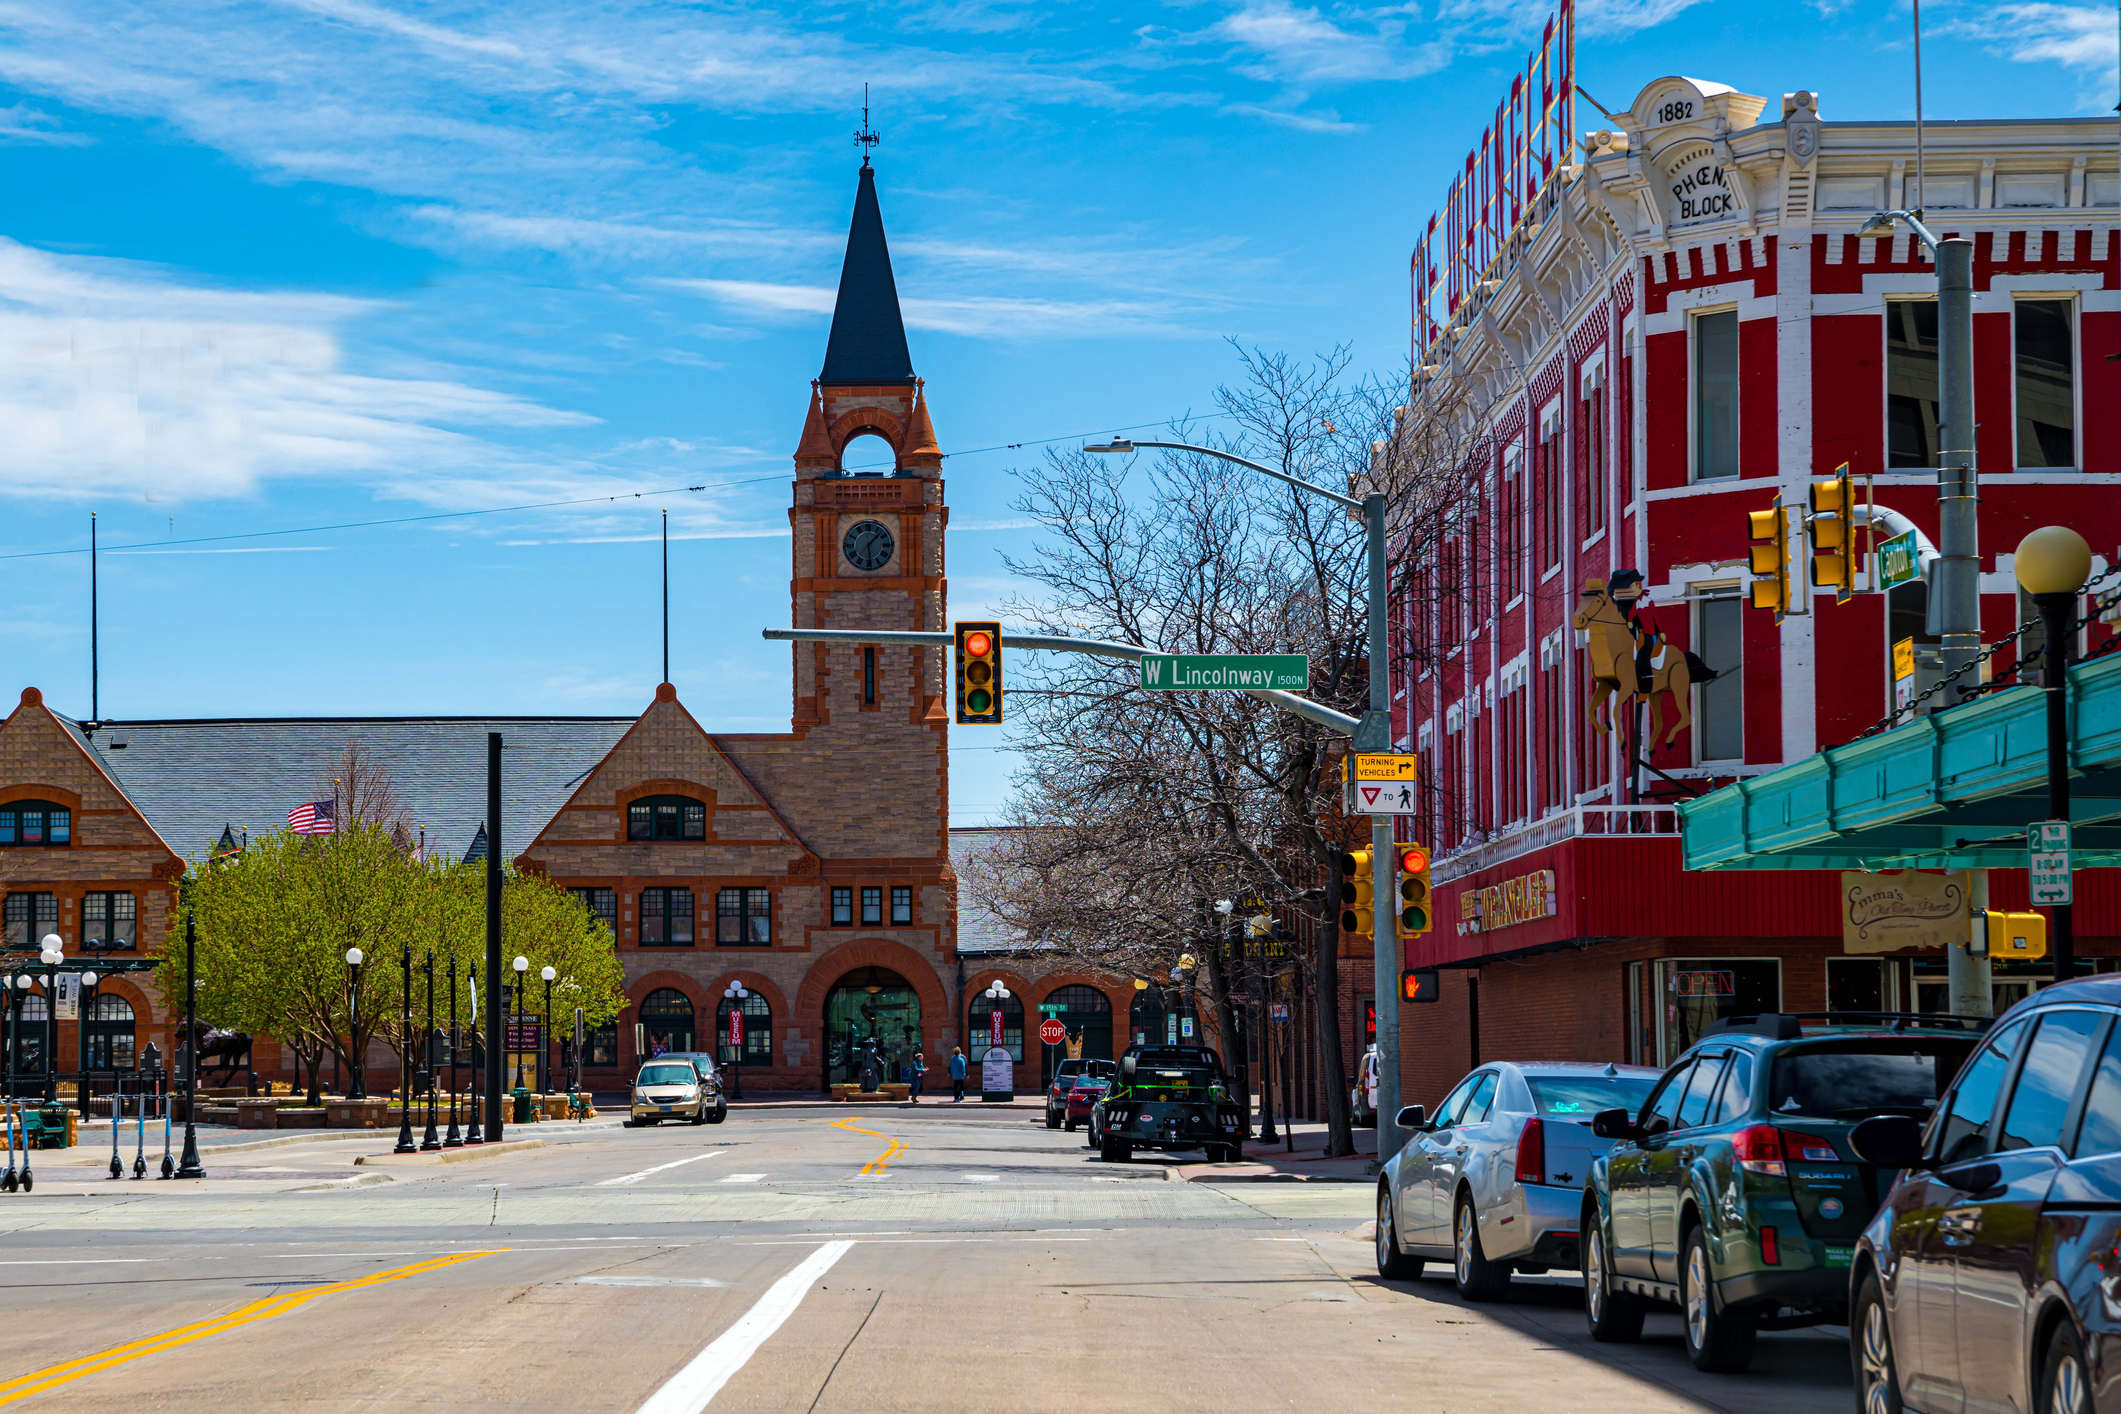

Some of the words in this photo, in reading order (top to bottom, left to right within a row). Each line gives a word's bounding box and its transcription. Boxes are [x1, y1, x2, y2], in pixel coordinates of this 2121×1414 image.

[1658, 102, 1692, 123] 1882
[1681, 193, 1732, 219] BLOCK
[1880, 537, 1909, 583] Capitol
[1145, 660, 1161, 685] W
[1172, 660, 1273, 688] Lincolnway
[1277, 675, 1303, 685] 1500N
[1359, 768, 1396, 776] VEHICLES
[1361, 758, 1394, 766] TURNING
[1383, 793, 1394, 801] TO
[2030, 830, 2040, 849] 2
[2036, 859, 2053, 870] 8:00
[2054, 858, 2064, 869] AM
[2033, 874, 2041, 885] TO
[2042, 874, 2058, 885] 5:00
[2059, 873, 2068, 884] PM
[1481, 869, 1552, 931] WRANGLER
[1848, 886, 1904, 926] Emma's
[1871, 904, 1890, 916] Old
[1891, 901, 1915, 914] Time
[1677, 972, 1733, 995] OPEN
[731, 1011, 741, 1045] MUSEUM
[992, 1011, 1002, 1045] MUSEUM
[1042, 1027, 1063, 1037] STOP
